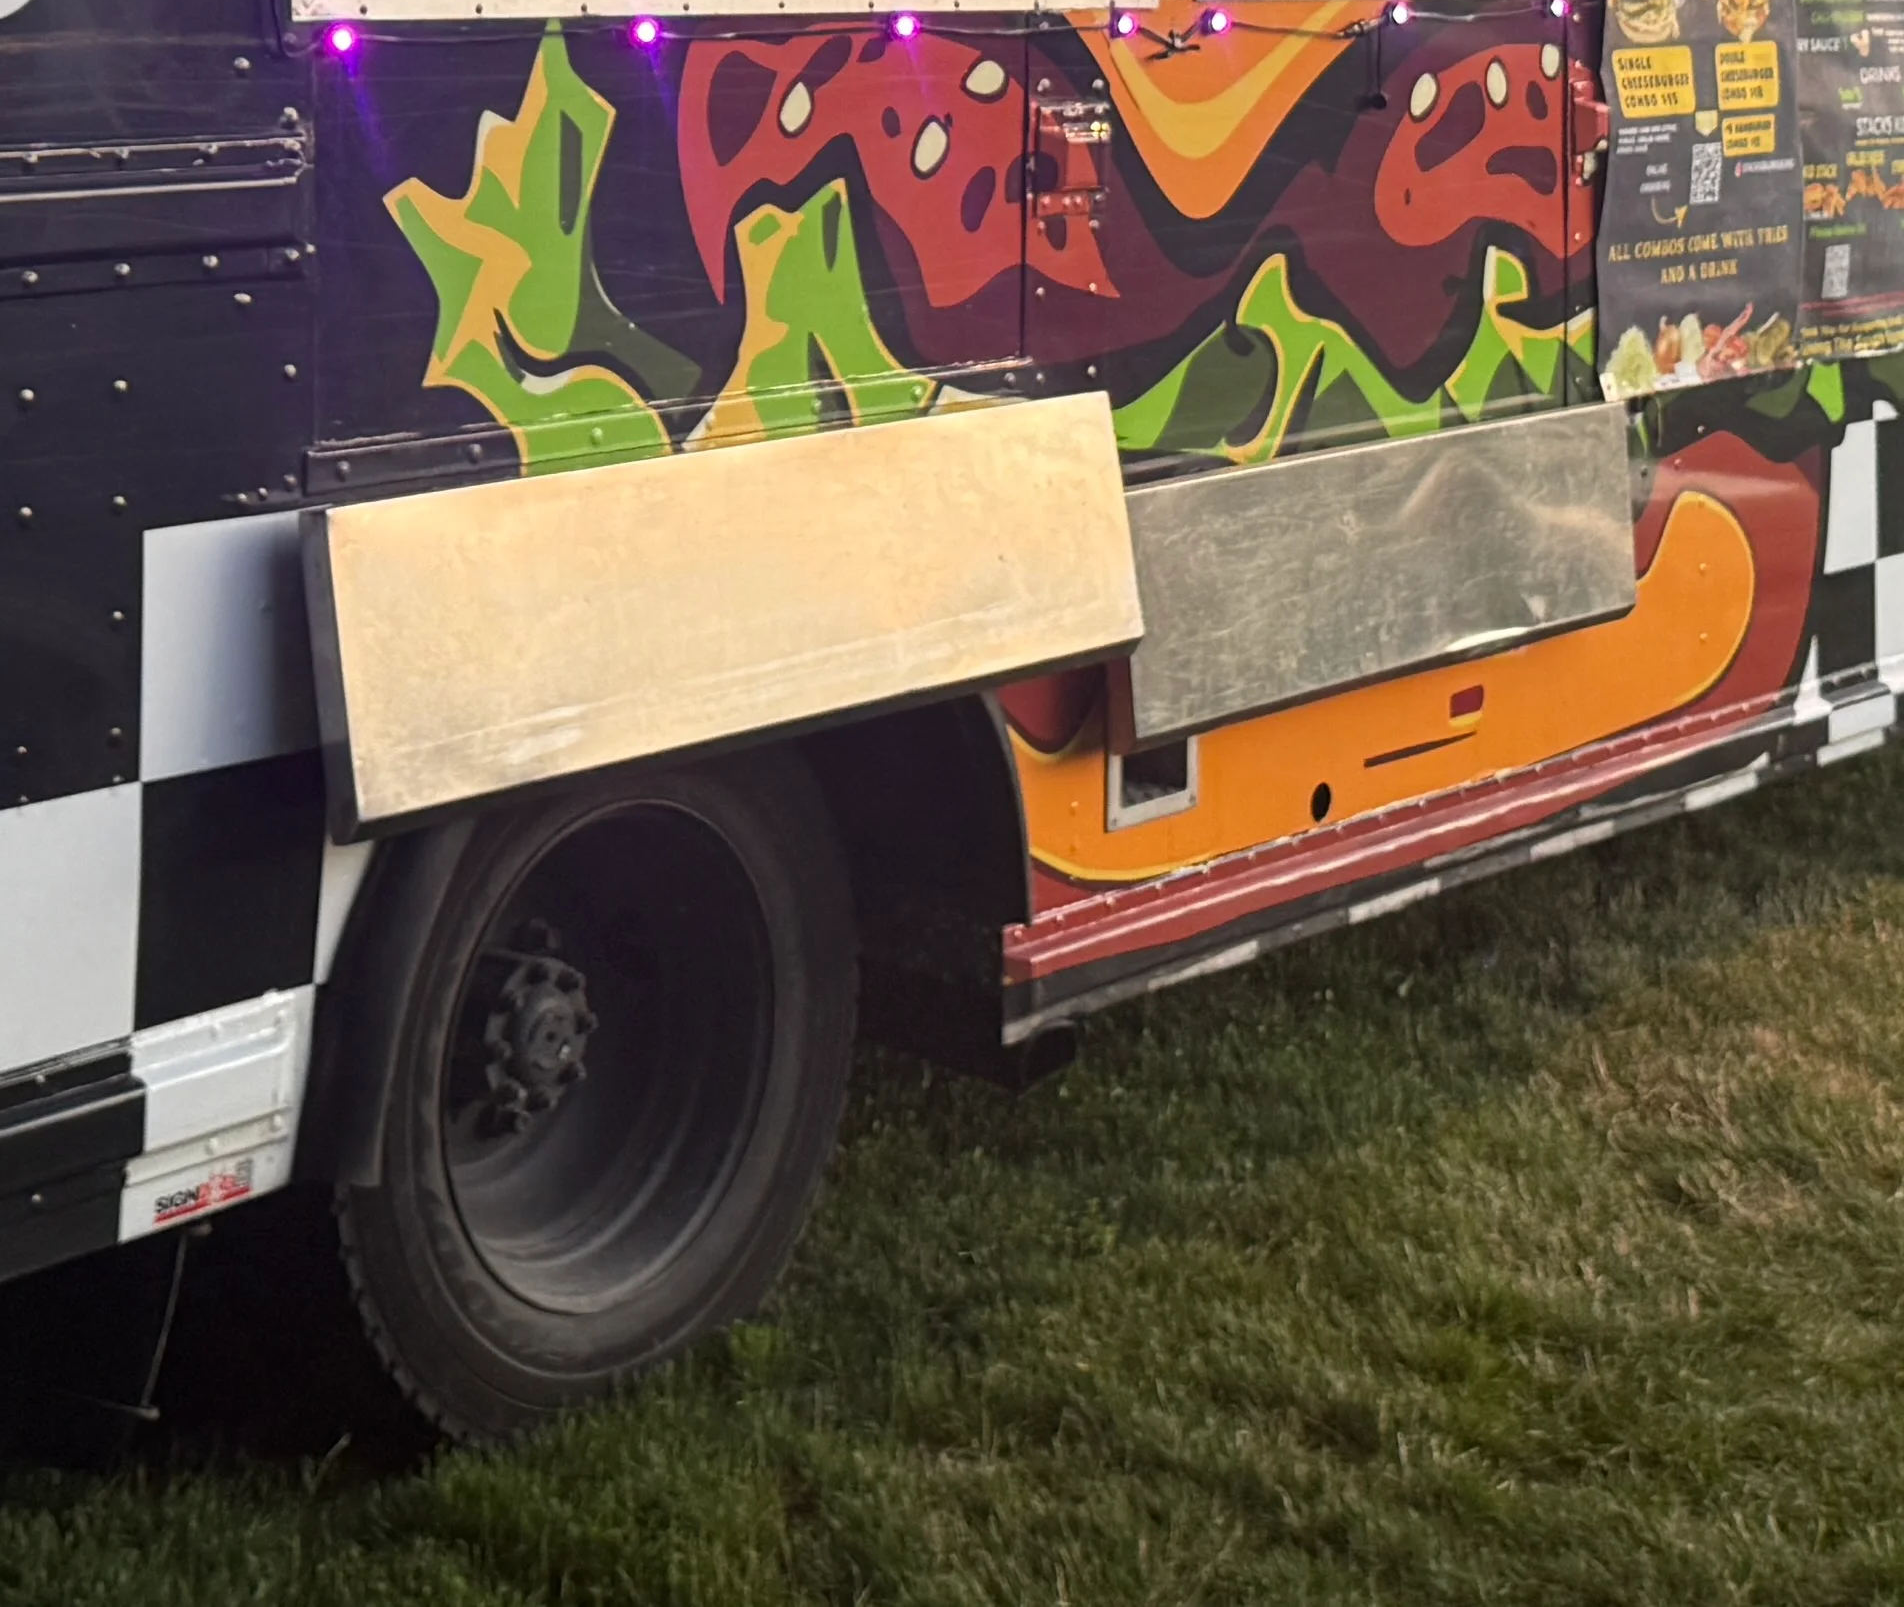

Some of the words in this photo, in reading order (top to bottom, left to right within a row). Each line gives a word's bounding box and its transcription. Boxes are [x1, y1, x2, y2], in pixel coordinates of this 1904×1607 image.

[1618, 56, 1651, 70] SINGLE
[1622, 73, 1689, 90] CHEESEBURGER
[1624, 94, 1658, 109] COMBO
[1608, 245, 1630, 262] ALL
[1634, 238, 1684, 260] COMBOS
[1688, 232, 1719, 253] COME
[1660, 265, 1684, 284] AND
[1688, 264, 1696, 281] A
